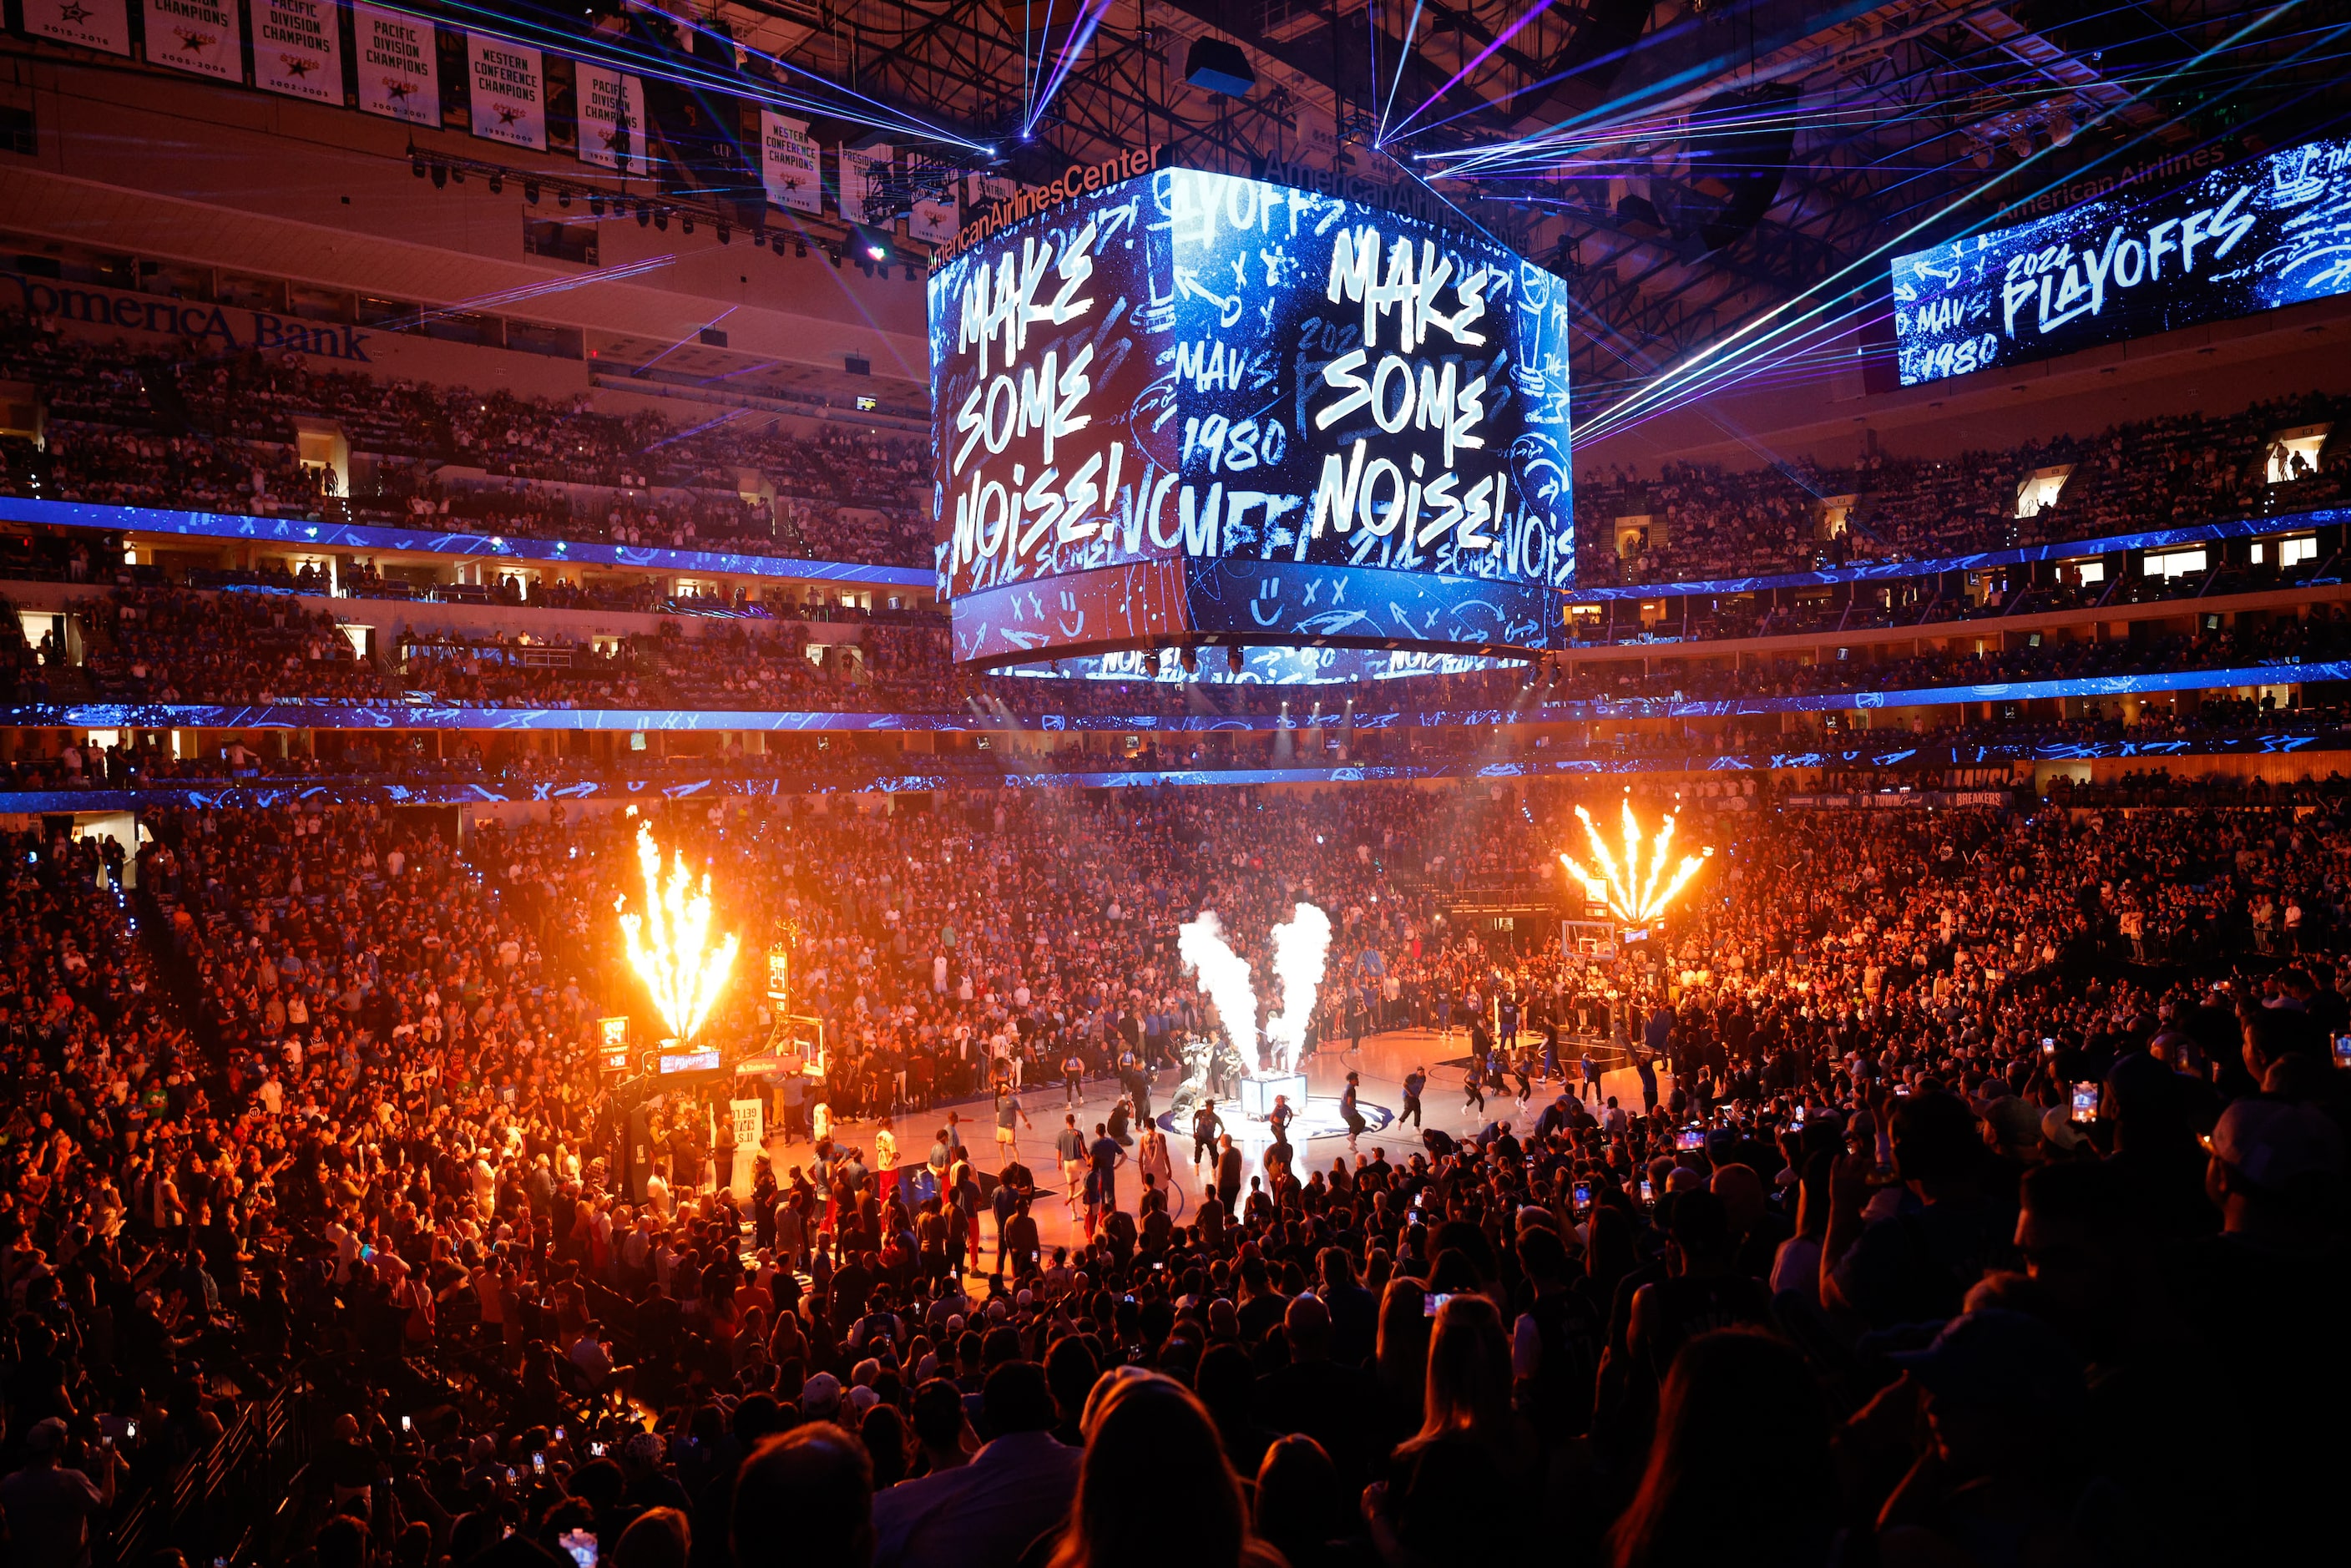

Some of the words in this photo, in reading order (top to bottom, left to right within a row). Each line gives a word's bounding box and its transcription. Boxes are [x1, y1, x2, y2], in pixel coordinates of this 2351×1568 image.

[155, 0, 229, 28] CHAMPIONS
[270, 11, 321, 34] DIVISION
[43, 23, 109, 45] 2015-2016
[263, 25, 331, 53] CHAMPIONS
[374, 21, 417, 43] PACIFIC
[373, 36, 419, 58] DIVISION
[483, 48, 528, 71] WESTERN
[366, 50, 428, 76] CHAMPIONS
[474, 61, 538, 88] CONFERENCE
[478, 78, 535, 102] CHAMPIONS
[593, 79, 628, 99] PACIFC
[766, 136, 816, 159] CONFERENCE
[769, 150, 814, 172] CHAMPIONS
[1995, 177, 2114, 224] American
[2118, 142, 2226, 186] Airlines
[2000, 185, 2257, 341] PLAYOFFS
[2005, 243, 2075, 282] 2024
[958, 221, 1097, 381] MAKE
[1327, 226, 1488, 354] MAKE
[251, 312, 372, 362] Bank
[1921, 332, 1998, 378] 1980
[953, 342, 1095, 477] SOME
[1315, 348, 1487, 468] SOME
[1181, 416, 1287, 474] 1980
[952, 441, 1125, 576] NOISE!
[1312, 438, 1507, 559] NOISE!
[1955, 792, 2001, 808] BREAKERS
[770, 968, 786, 989] 24
